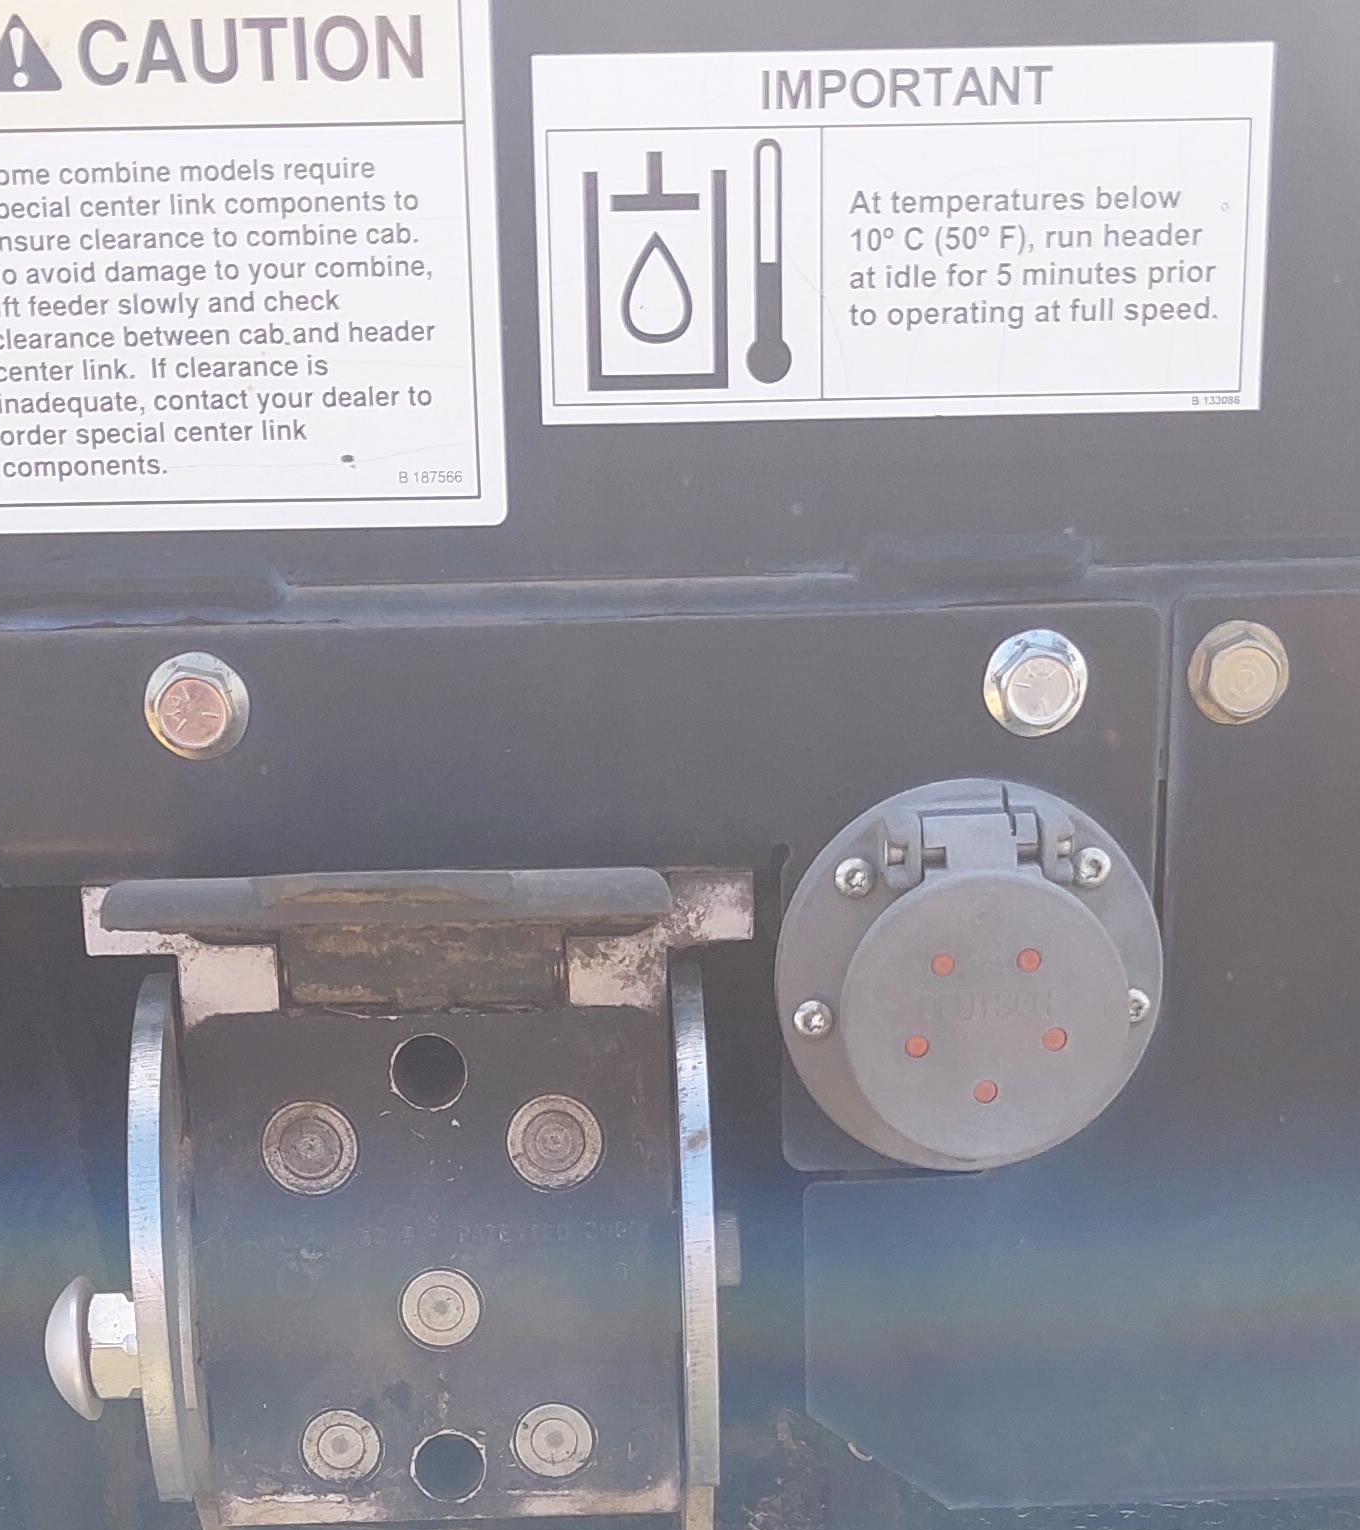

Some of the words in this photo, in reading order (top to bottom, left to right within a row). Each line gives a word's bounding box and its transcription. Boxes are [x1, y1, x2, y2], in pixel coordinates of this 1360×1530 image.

[77, 14, 424, 87] CAUTION
[761, 64, 1054, 110] IMPORTANT
[58, 160, 171, 185] combine
[179, 158, 275, 182] models
[283, 156, 375, 186] require
[79, 195, 161, 218] center
[169, 192, 217, 216] link
[224, 190, 386, 220] components
[393, 190, 419, 212] to
[848, 190, 882, 215] At
[889, 188, 1085, 220] temperatures
[1095, 184, 1182, 210] below
[79, 228, 205, 251] clearance
[211, 226, 238, 249] to
[246, 223, 358, 247] combine
[365, 222, 419, 245] cab.
[904, 226, 924, 252] C
[999, 224, 1034, 256] F),
[1045, 230, 1092, 249] run
[1103, 222, 1203, 248] header
[25, 261, 96, 285] avoid
[104, 260, 207, 287] damage
[213, 259, 240, 281] to
[247, 261, 307, 286] your
[314, 254, 433, 281] combine,
[849, 266, 876, 290] at
[885, 263, 937, 289] idle
[945, 262, 988, 288] for
[997, 262, 1012, 287] 5
[1022, 261, 1137, 286] minutes
[1147, 259, 1217, 290] prior
[27, 294, 110, 317] feeder
[117, 291, 200, 320] slowly
[208, 290, 255, 314] and
[263, 288, 340, 313] check
[848, 303, 877, 327] to
[887, 299, 1024, 332] operating
[1034, 299, 1061, 323] at
[1069, 297, 1114, 322] full
[1123, 295, 1218, 327] speed.
[122, 325, 230, 348] between
[292, 321, 340, 345] and
[348, 319, 436, 343] header
[82, 357, 136, 381] link.
[150, 357, 167, 379] If
[175, 356, 299, 379] clearance
[306, 353, 329, 377] is
[153, 389, 249, 412] contact
[256, 391, 314, 415] your
[321, 385, 401, 409] dealer
[407, 385, 432, 407] to
[1191, 396, 1200, 406] B
[0, 423, 68, 447] order
[75, 421, 165, 450] special
[173, 421, 254, 443] center
[261, 418, 308, 441] link
[2, 454, 168, 482] components.
[398, 470, 409, 484] B
[413, 470, 463, 484] 187566
